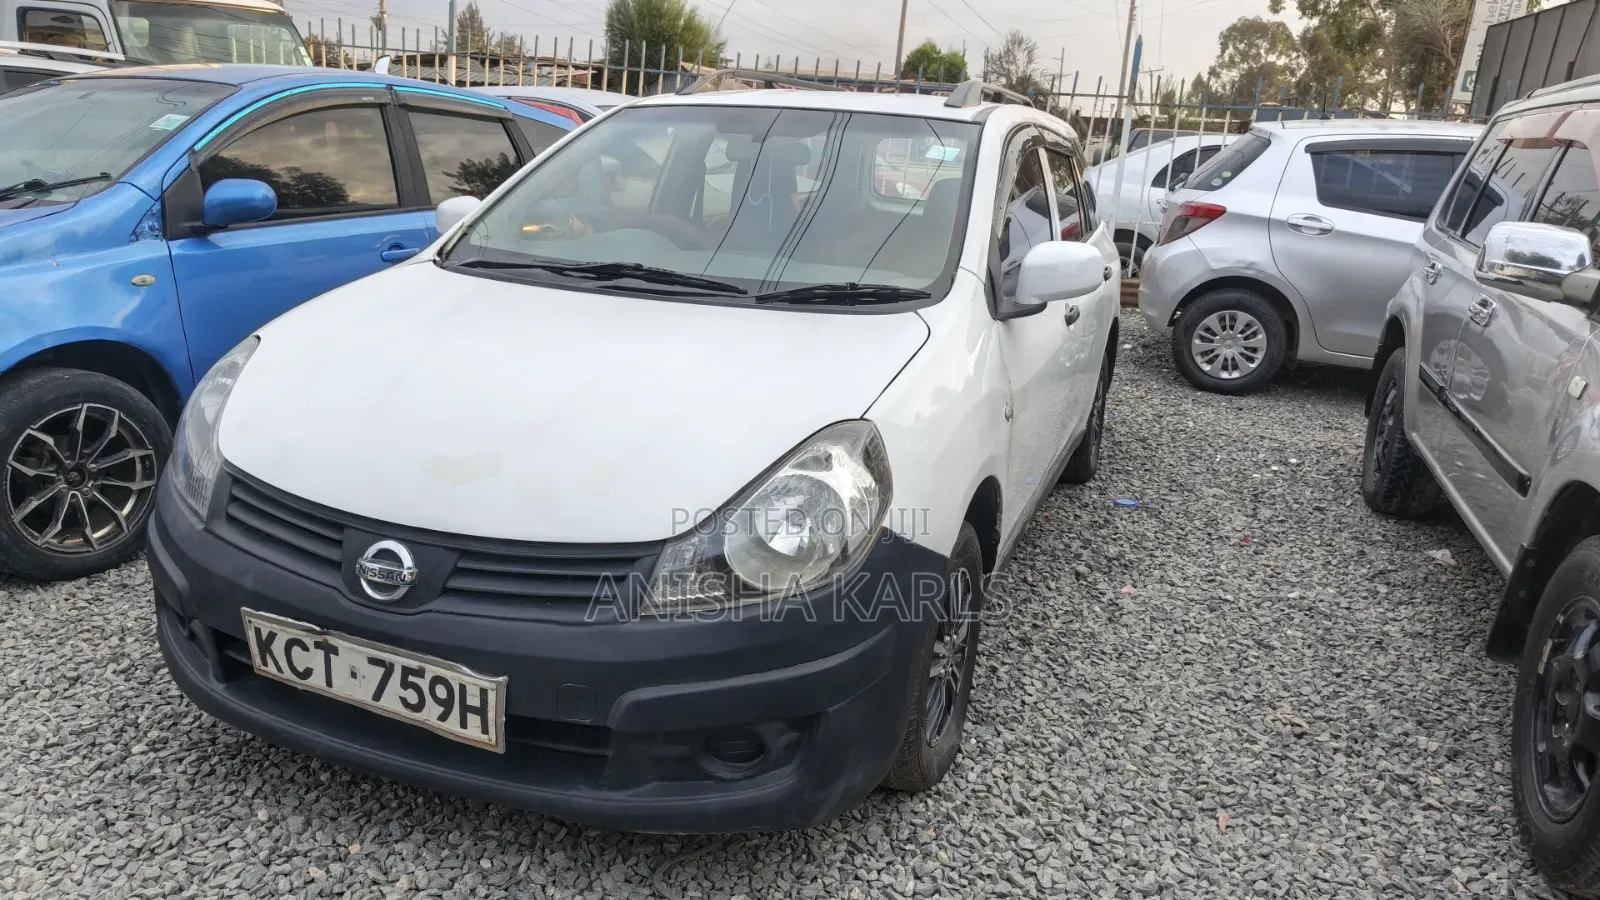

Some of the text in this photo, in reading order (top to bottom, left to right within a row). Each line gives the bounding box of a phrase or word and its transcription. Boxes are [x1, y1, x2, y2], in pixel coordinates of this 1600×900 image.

[359, 564, 407, 582] NISSAN
[253, 626, 490, 736] KCT 759H
